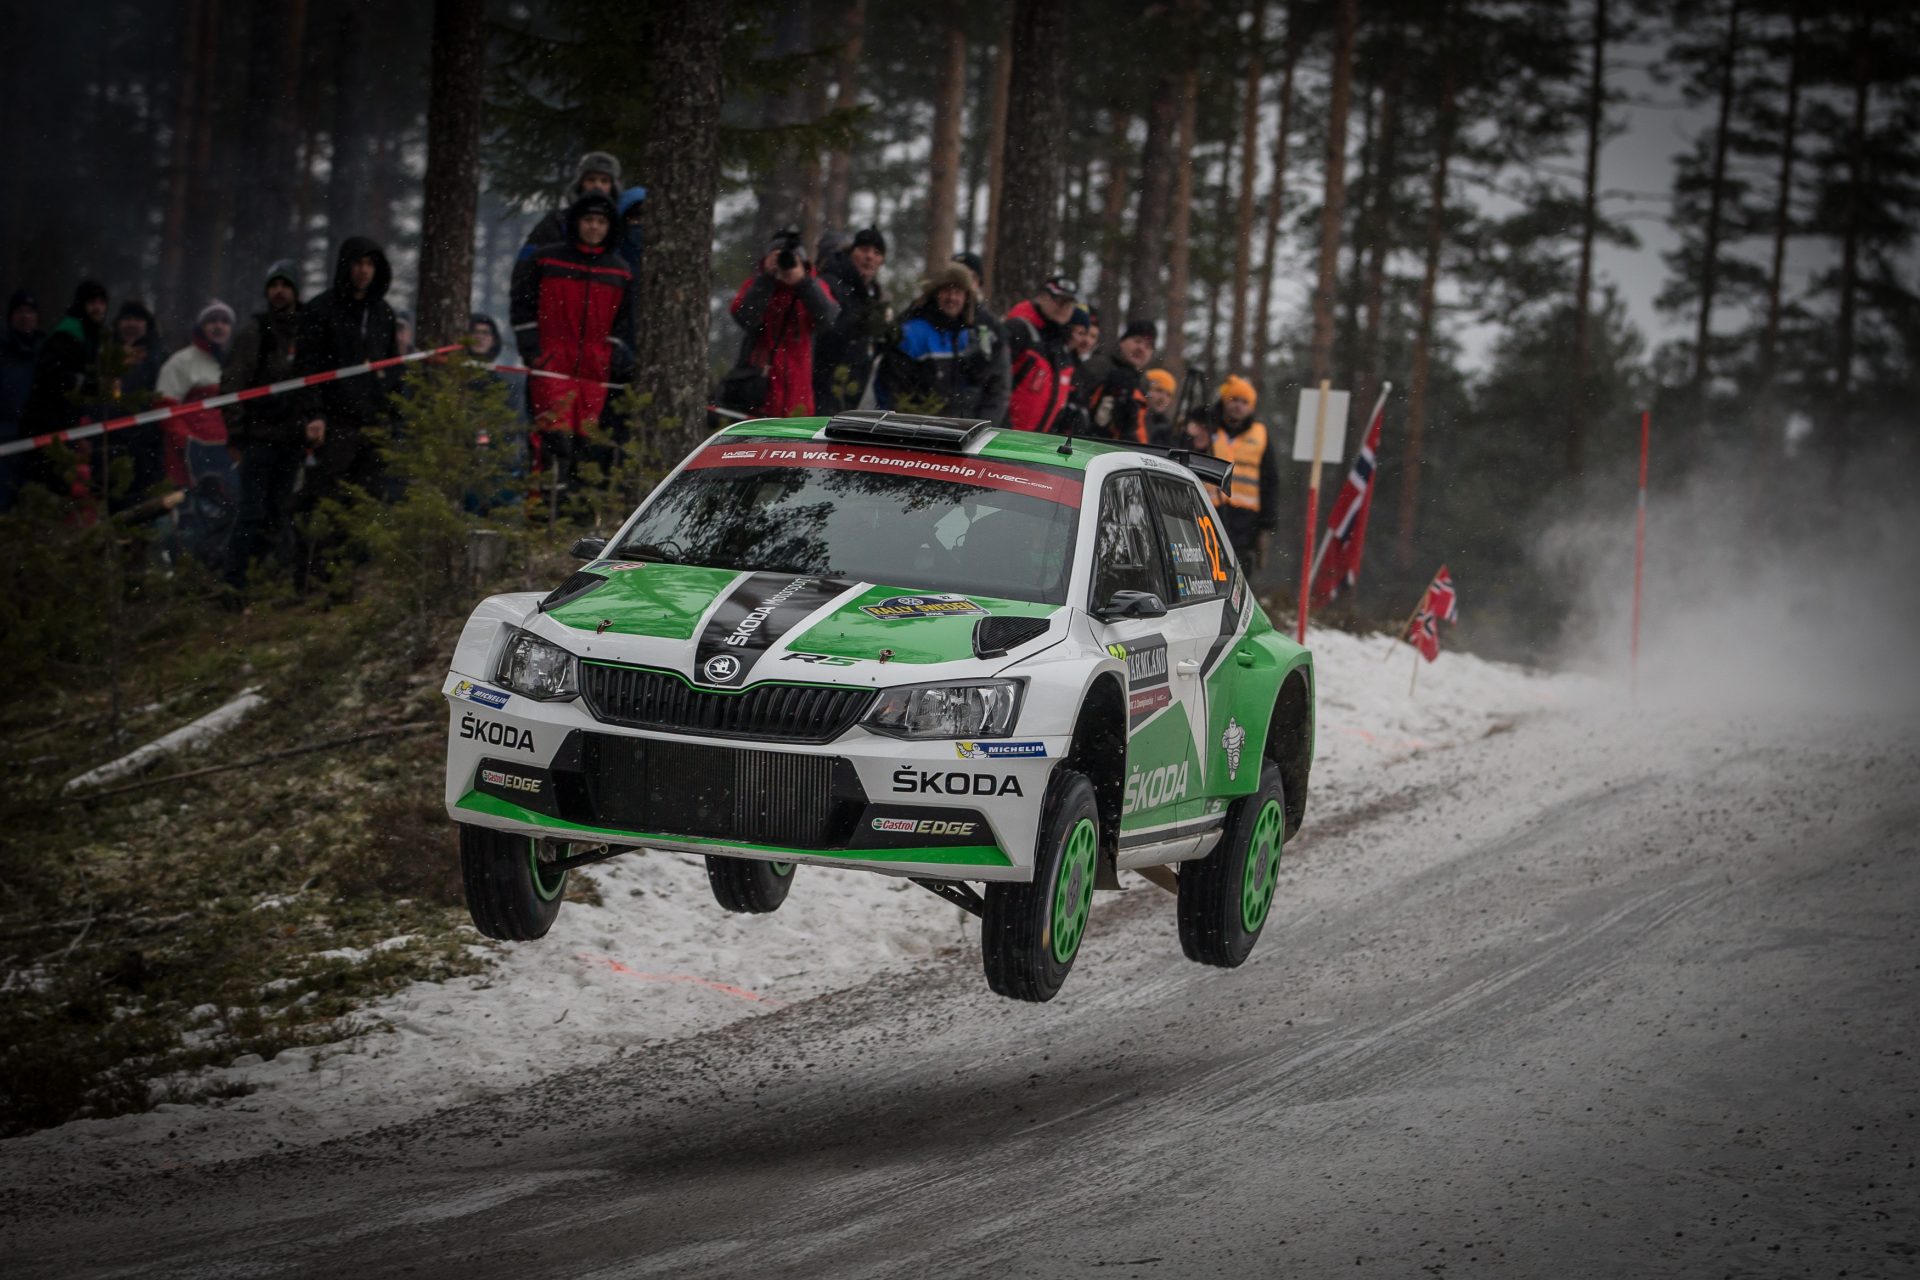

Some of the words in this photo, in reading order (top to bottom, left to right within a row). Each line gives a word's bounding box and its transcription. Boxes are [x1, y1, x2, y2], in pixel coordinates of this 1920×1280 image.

[769, 450, 797, 459] FIA
[802, 451, 840, 461] WRC
[843, 453, 854, 462] 2
[859, 454, 976, 478] Championship
[723, 606, 776, 646] ŠKODA
[762, 577, 812, 606] Motorsport
[868, 606, 914, 615] RALLY
[916, 601, 977, 612] SWEDEN
[474, 689, 510, 705] MICHELIN
[460, 712, 535, 753] ŠKODA
[988, 745, 1044, 753] MICHELIN
[487, 772, 504, 785] Castrol
[503, 774, 543, 793] EDGE
[892, 765, 1024, 797] ŠKODA
[1122, 760, 1189, 814] ŠKODA
[882, 819, 915, 831] Castrol
[916, 820, 977, 836] EDGE
